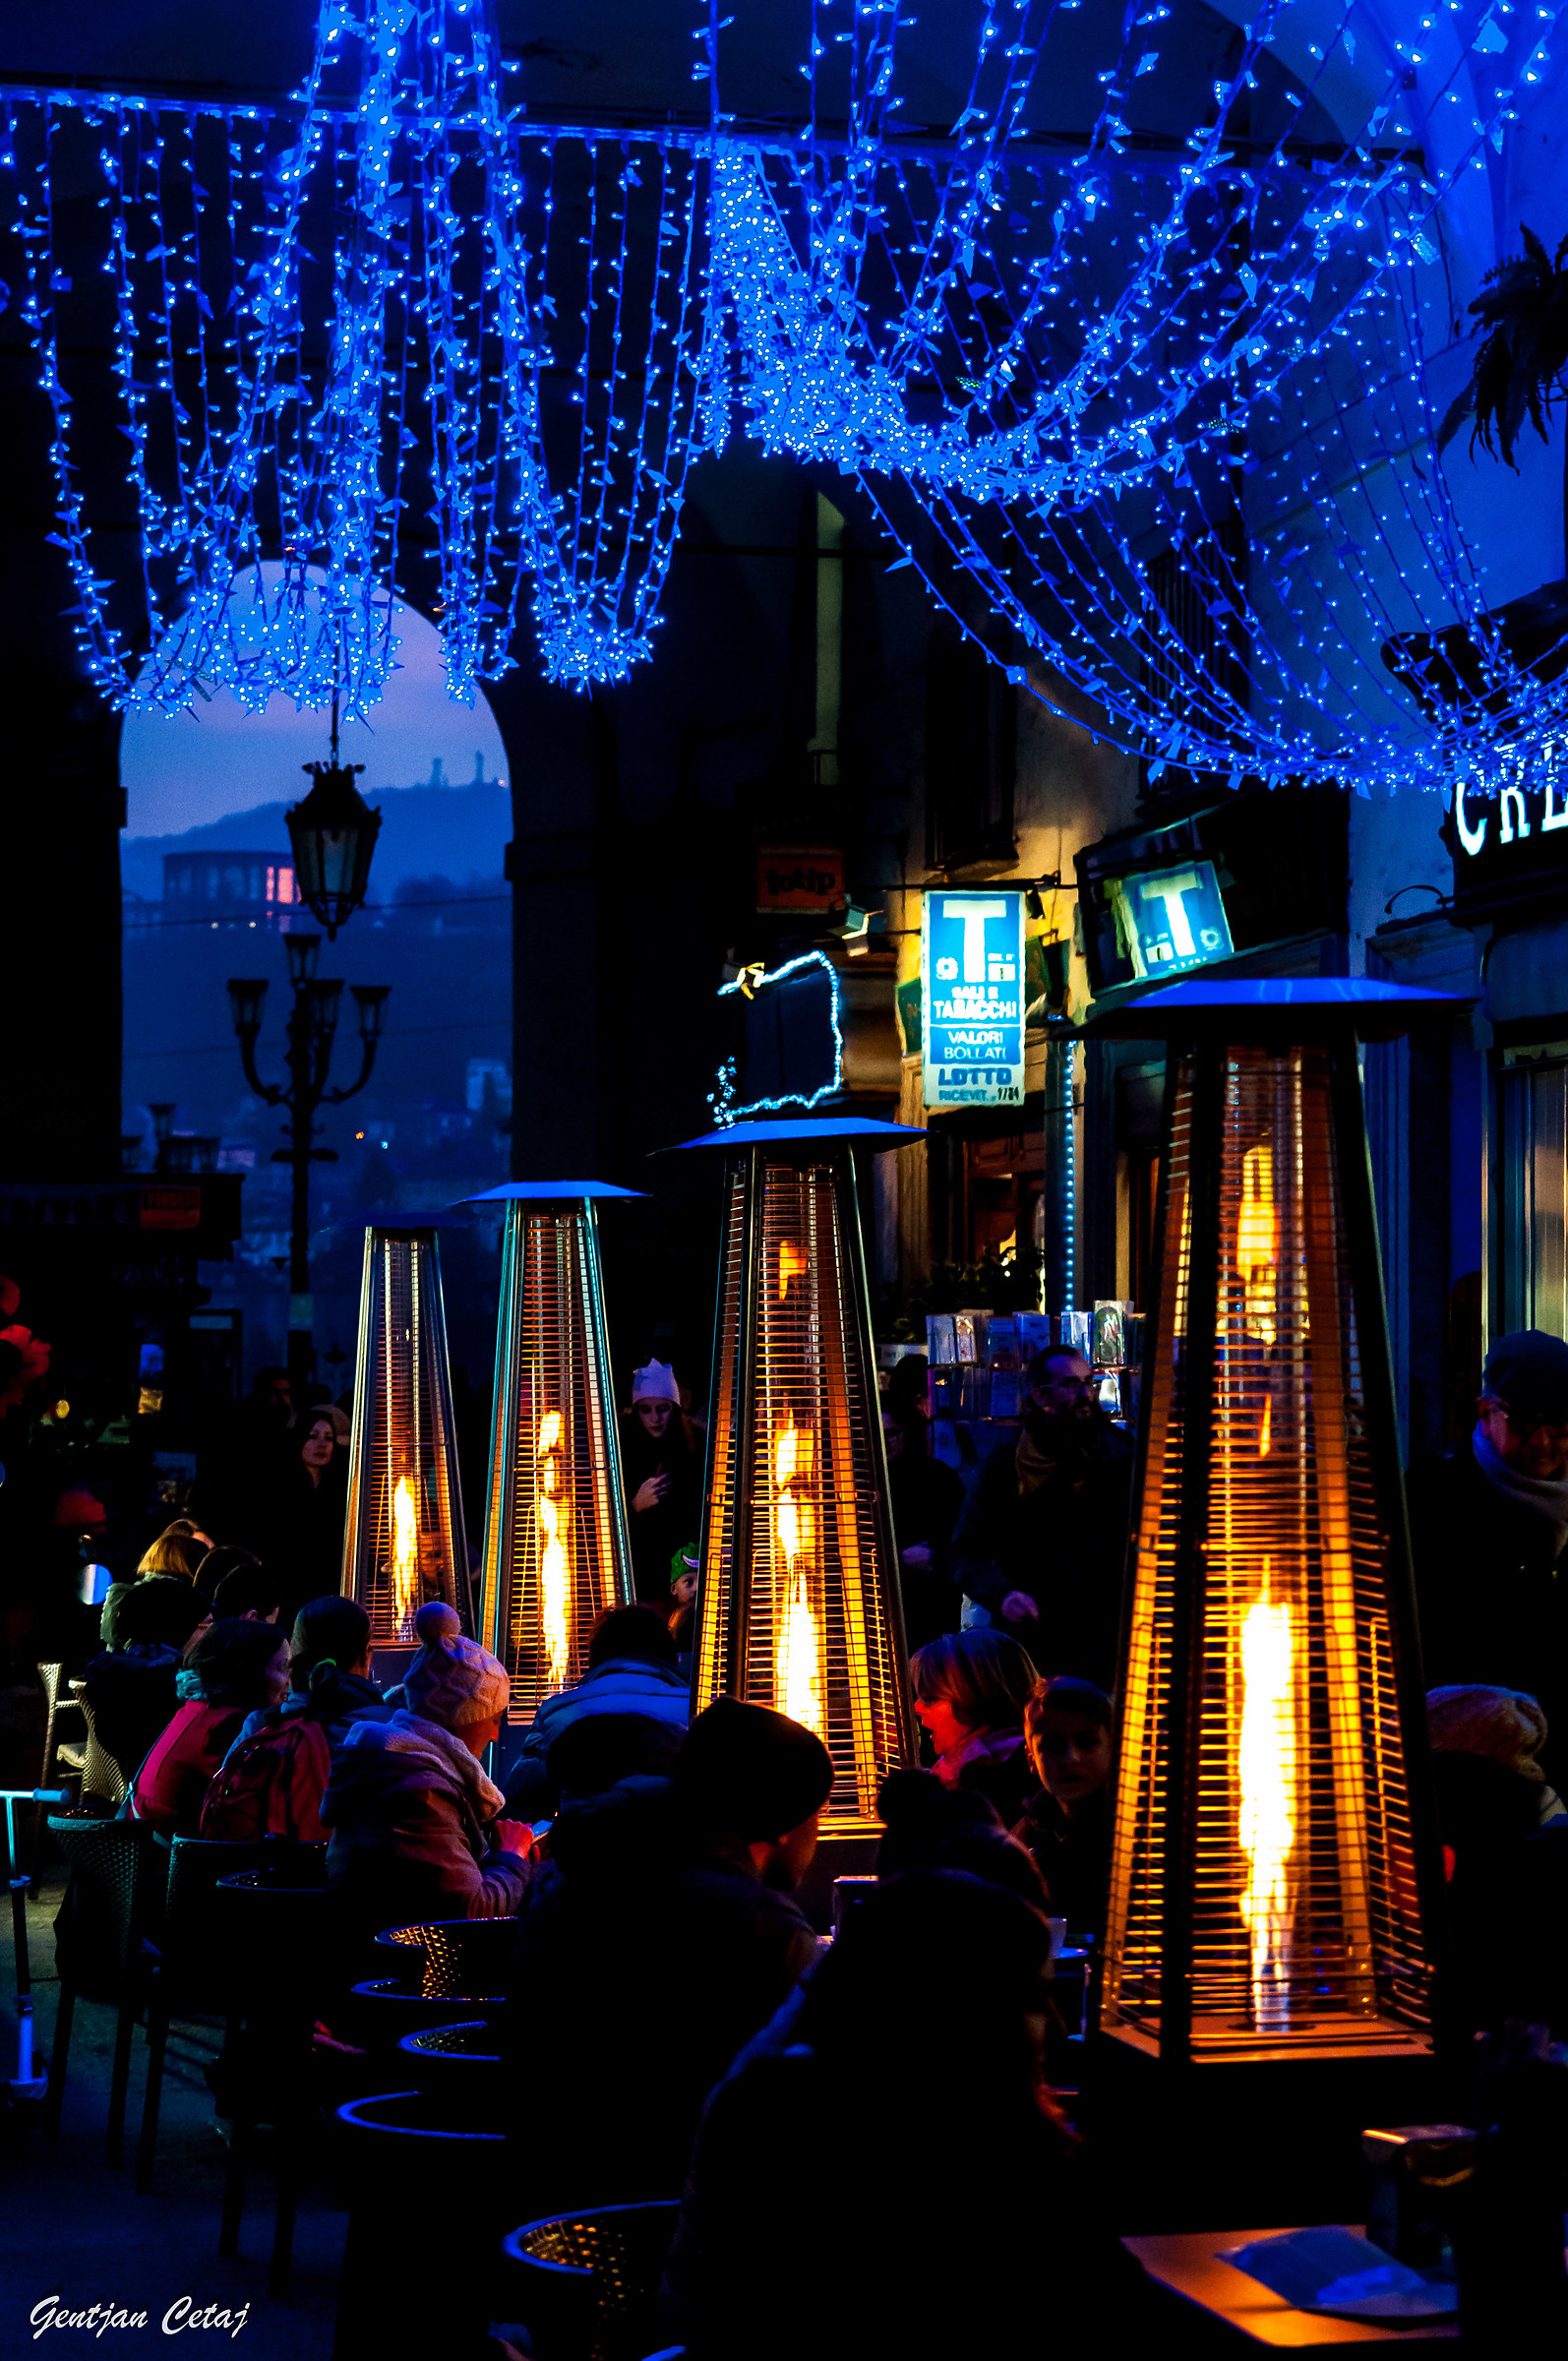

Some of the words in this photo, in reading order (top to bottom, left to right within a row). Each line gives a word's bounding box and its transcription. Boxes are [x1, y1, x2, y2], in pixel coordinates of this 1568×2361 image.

[1141, 871, 1203, 957] T
[942, 899, 1007, 983] T
[934, 999, 1017, 1020] TABACCHI
[947, 1030, 1003, 1045] VALORI
[944, 1047, 1006, 1059] BOLLATI
[938, 1067, 1012, 1086] LOTTO
